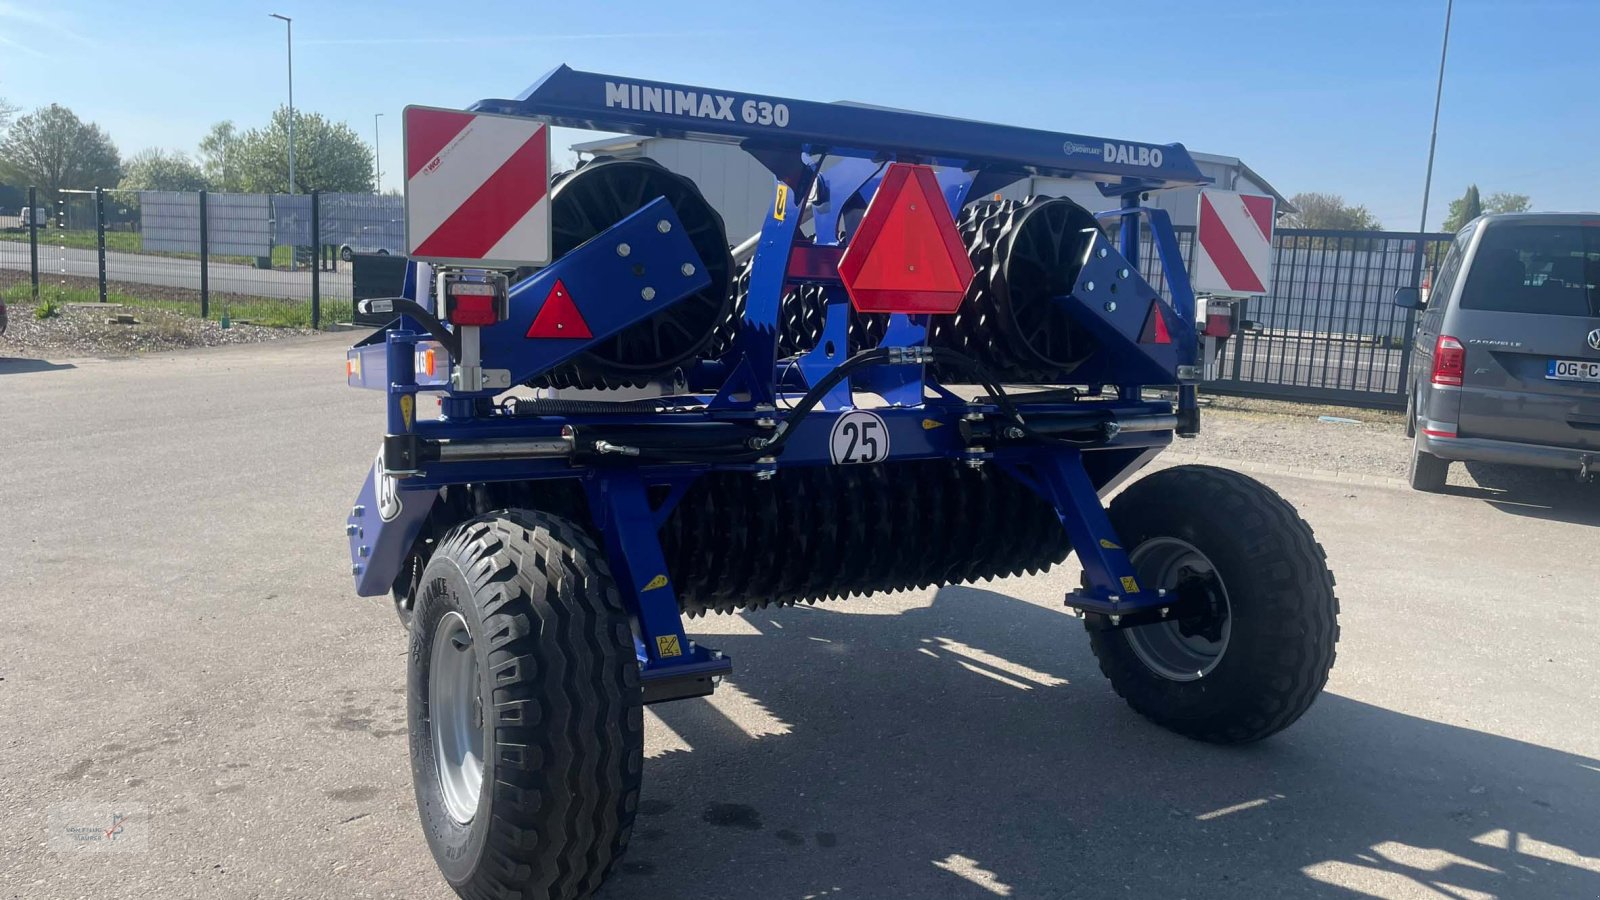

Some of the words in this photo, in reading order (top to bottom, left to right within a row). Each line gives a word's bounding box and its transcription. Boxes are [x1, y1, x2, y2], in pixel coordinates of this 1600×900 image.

[605, 81, 736, 122] MINIMAX
[741, 100, 790, 128] 630
[1103, 142, 1163, 168] DALBO
[1557, 361, 1578, 376] OG
[842, 421, 877, 463] 25
